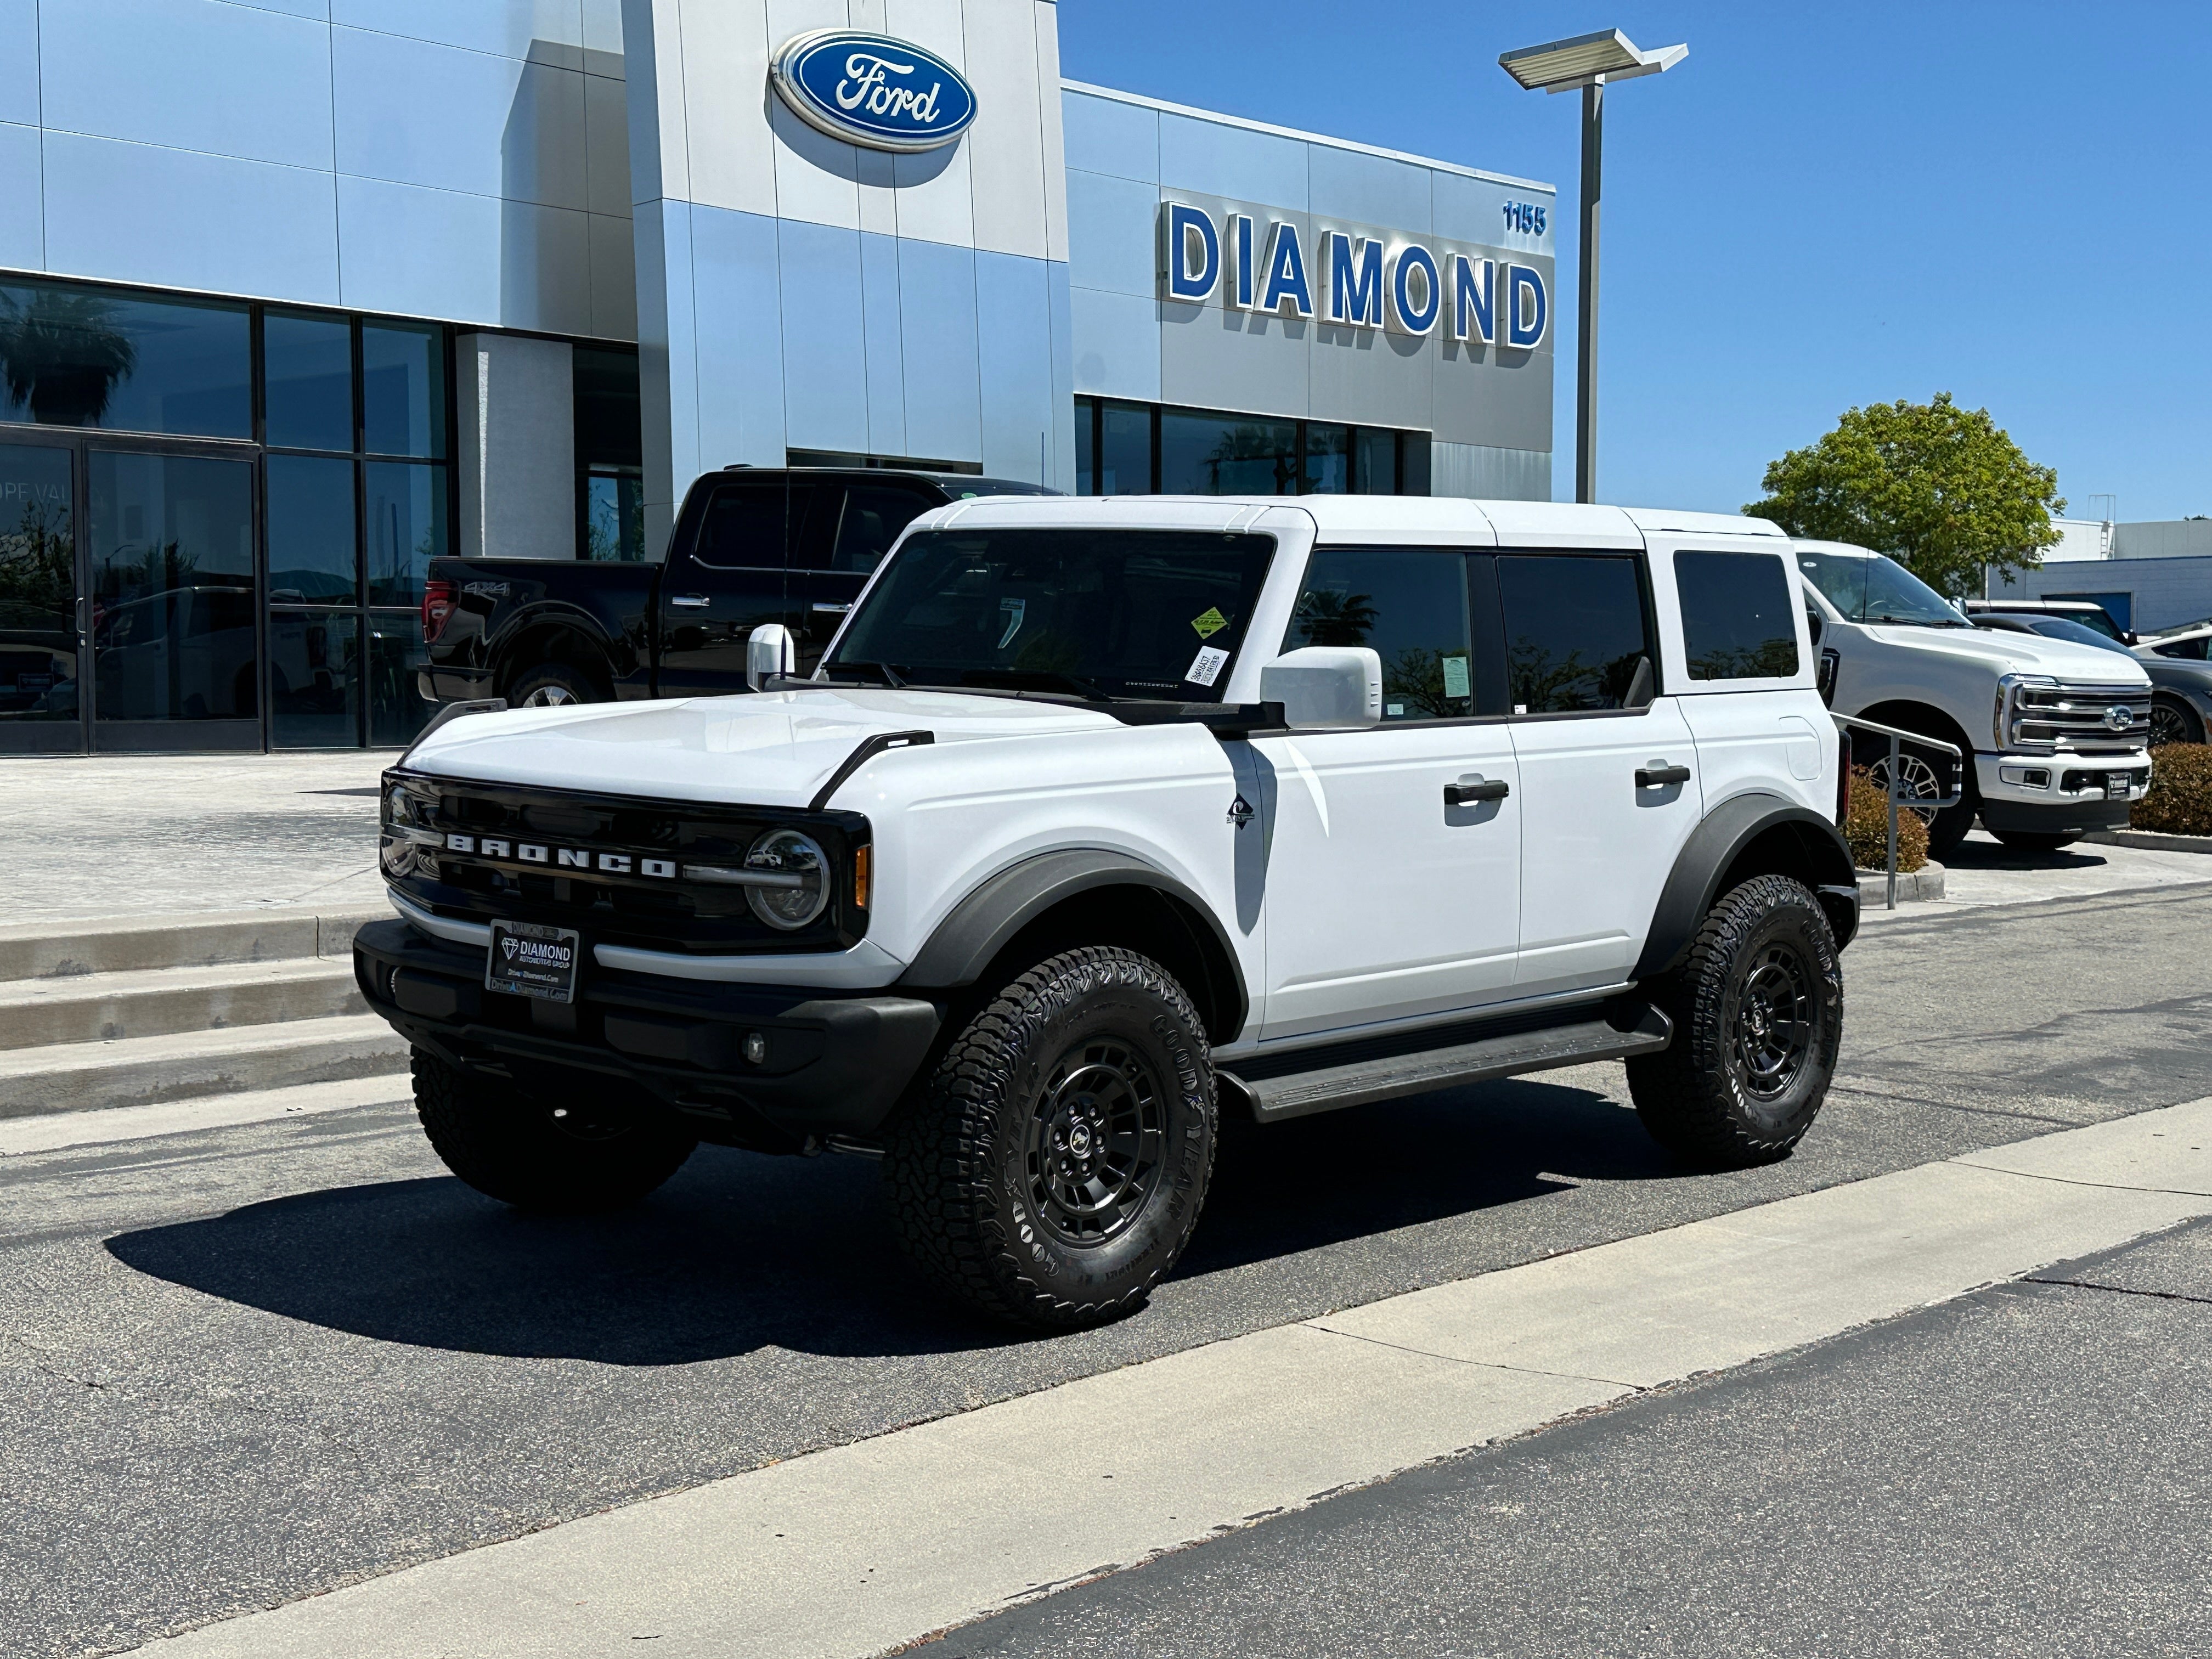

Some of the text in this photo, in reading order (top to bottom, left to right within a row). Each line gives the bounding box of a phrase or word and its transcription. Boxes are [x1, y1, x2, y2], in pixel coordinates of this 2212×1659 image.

[836, 53, 941, 122] Ford
[1503, 200, 1546, 236] 1155
[1161, 201, 1549, 349] DIAMOND
[447, 833, 676, 878] BRONCO
[520, 941, 571, 961] DIAMOND
